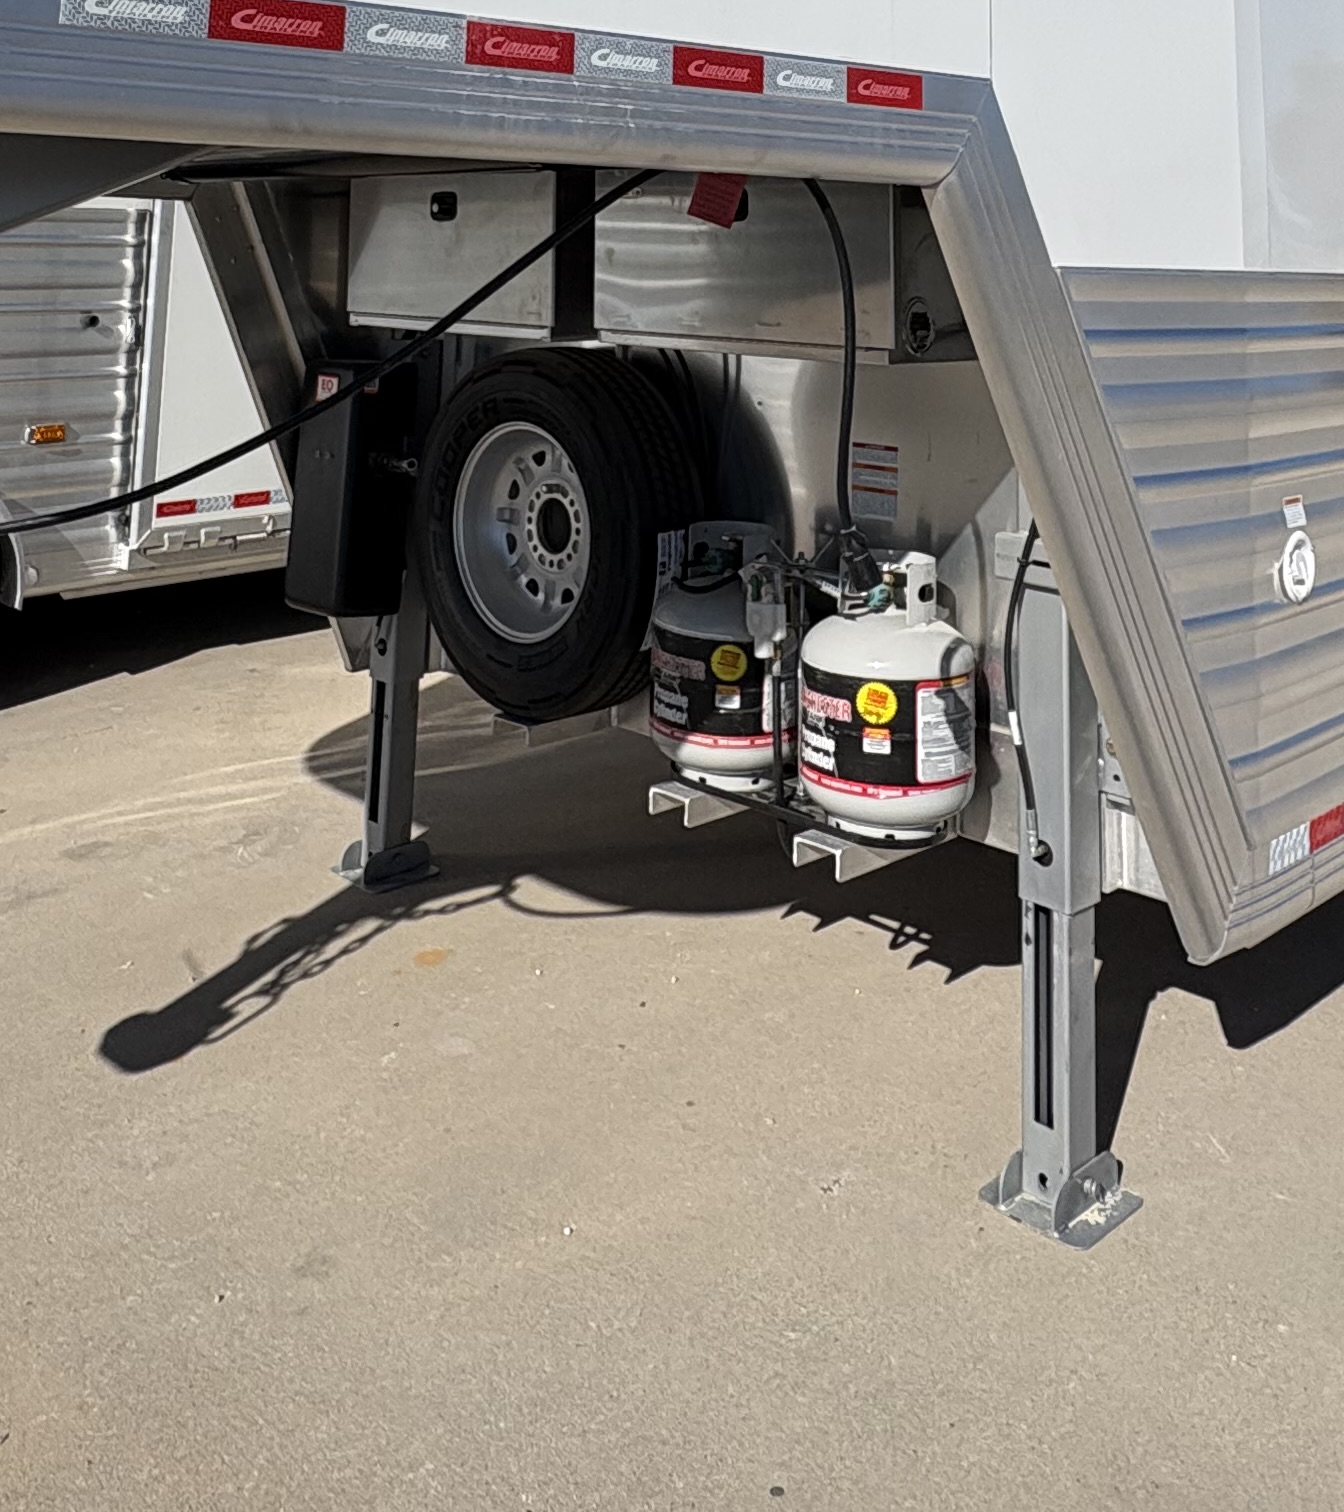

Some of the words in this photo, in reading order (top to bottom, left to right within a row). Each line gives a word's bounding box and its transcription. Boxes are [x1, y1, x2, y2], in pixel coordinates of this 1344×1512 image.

[231, 9, 323, 37] Cimarron
[367, 24, 449, 49] Cimarron
[484, 37, 559, 61] Cimarron
